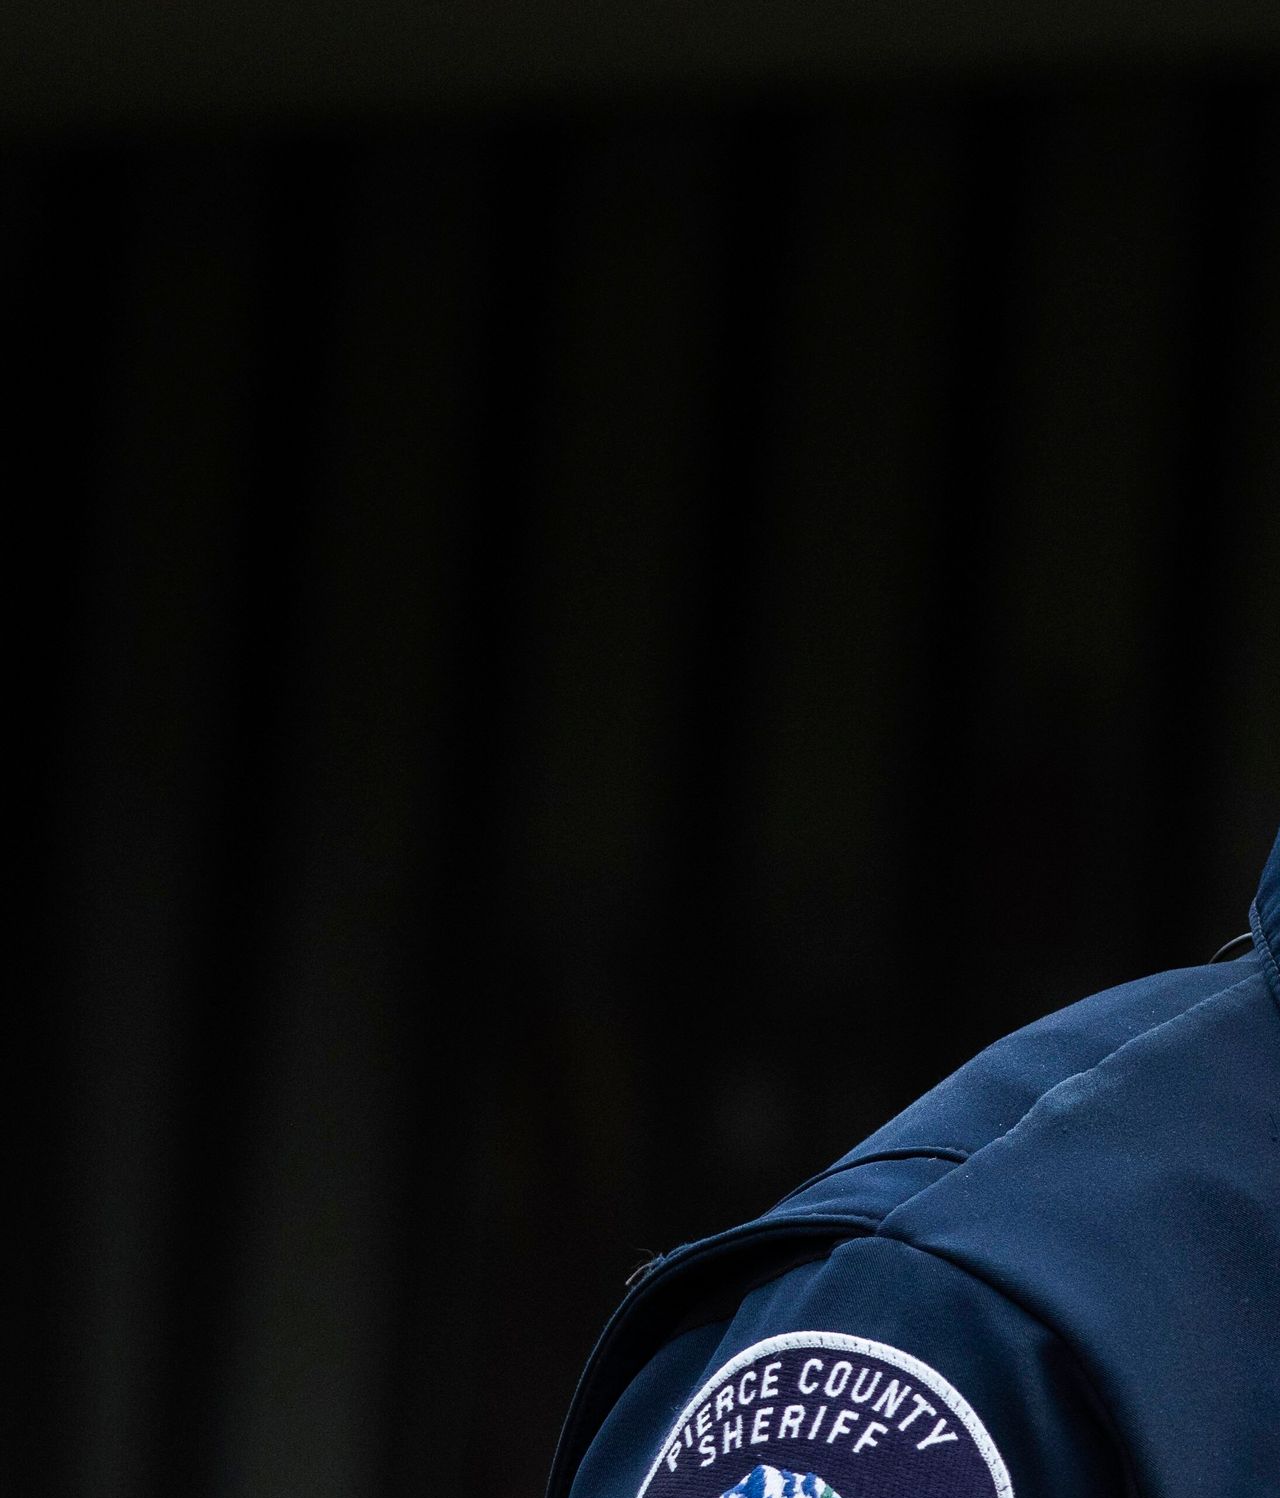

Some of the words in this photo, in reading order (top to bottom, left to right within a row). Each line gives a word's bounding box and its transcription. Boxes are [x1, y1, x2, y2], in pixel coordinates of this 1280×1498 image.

[667, 1361, 782, 1473] PIERCE
[798, 1358, 959, 1450] COUNTY
[698, 1405, 889, 1467] SHERIFF
